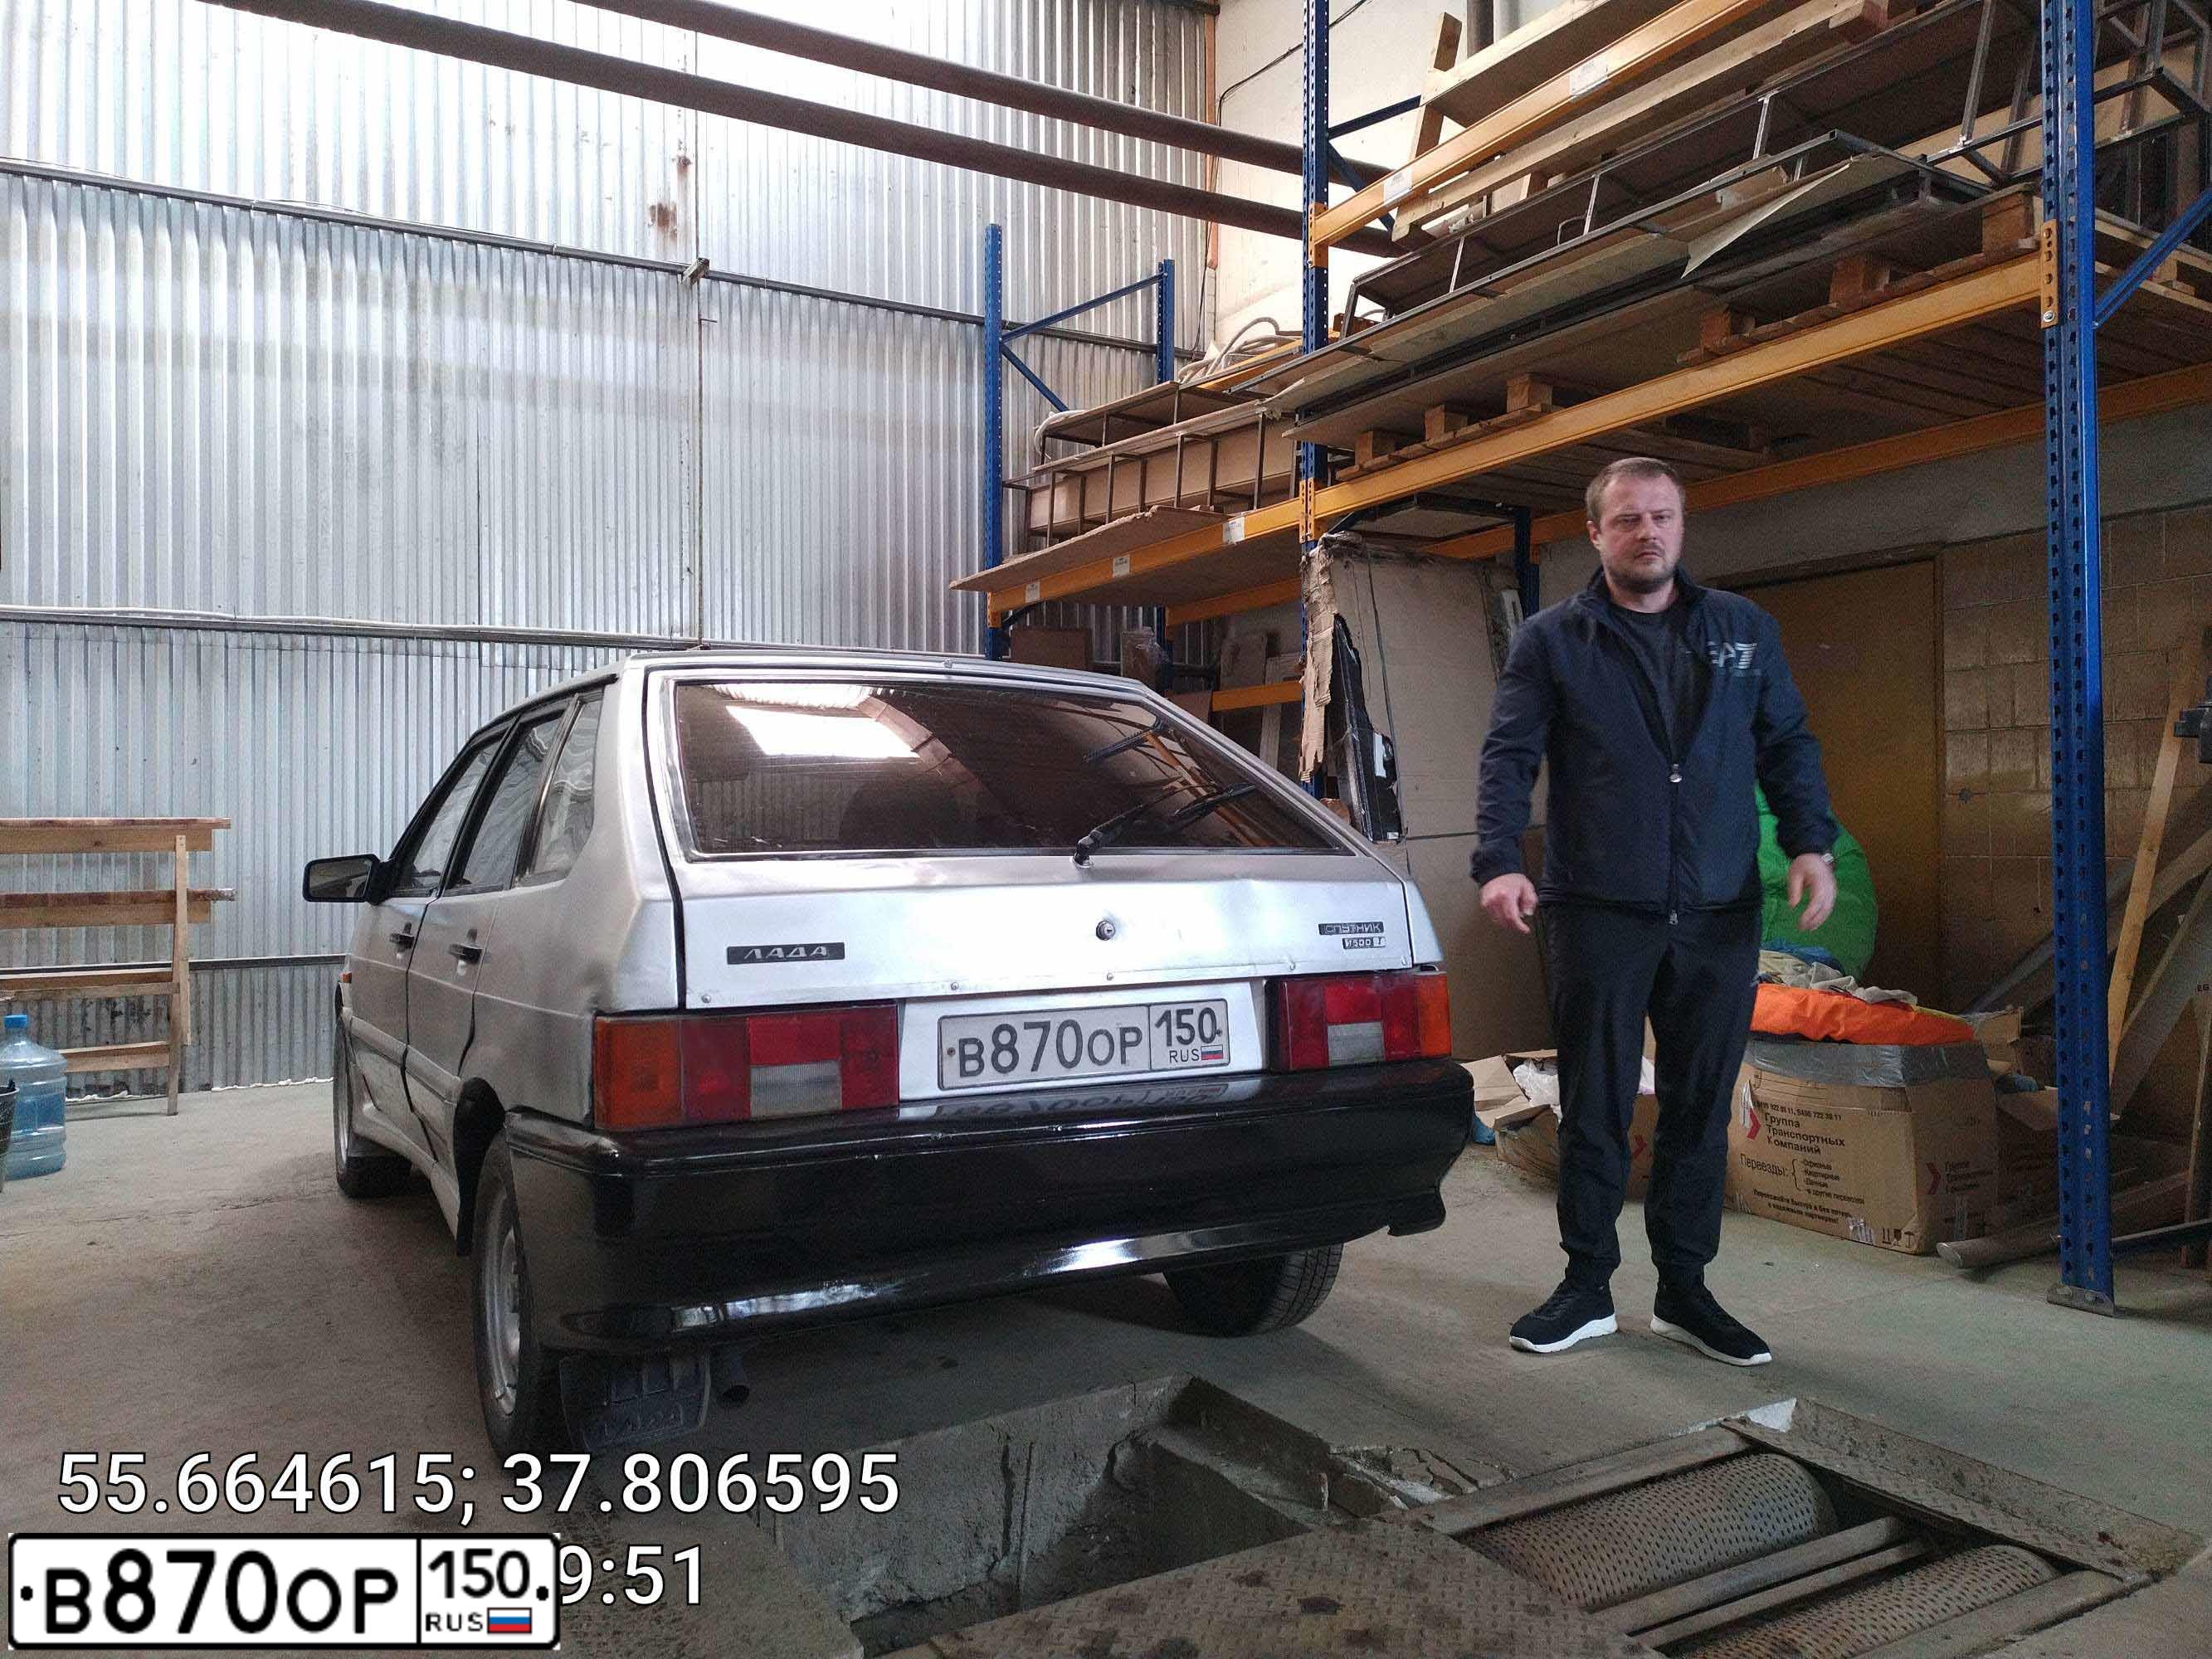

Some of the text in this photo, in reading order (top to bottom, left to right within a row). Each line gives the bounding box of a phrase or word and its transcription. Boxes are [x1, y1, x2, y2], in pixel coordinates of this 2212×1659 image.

[743, 946, 827, 960] ЛАДА
[1154, 1006, 1218, 1048] 150
[1169, 1048, 1201, 1064] RUS
[1764, 1112, 1800, 1128] Группа
[1766, 1123, 1845, 1146] Транспортных
[1766, 1135, 1821, 1155] Компаний
[1740, 1153, 1789, 1177] Переезды:
